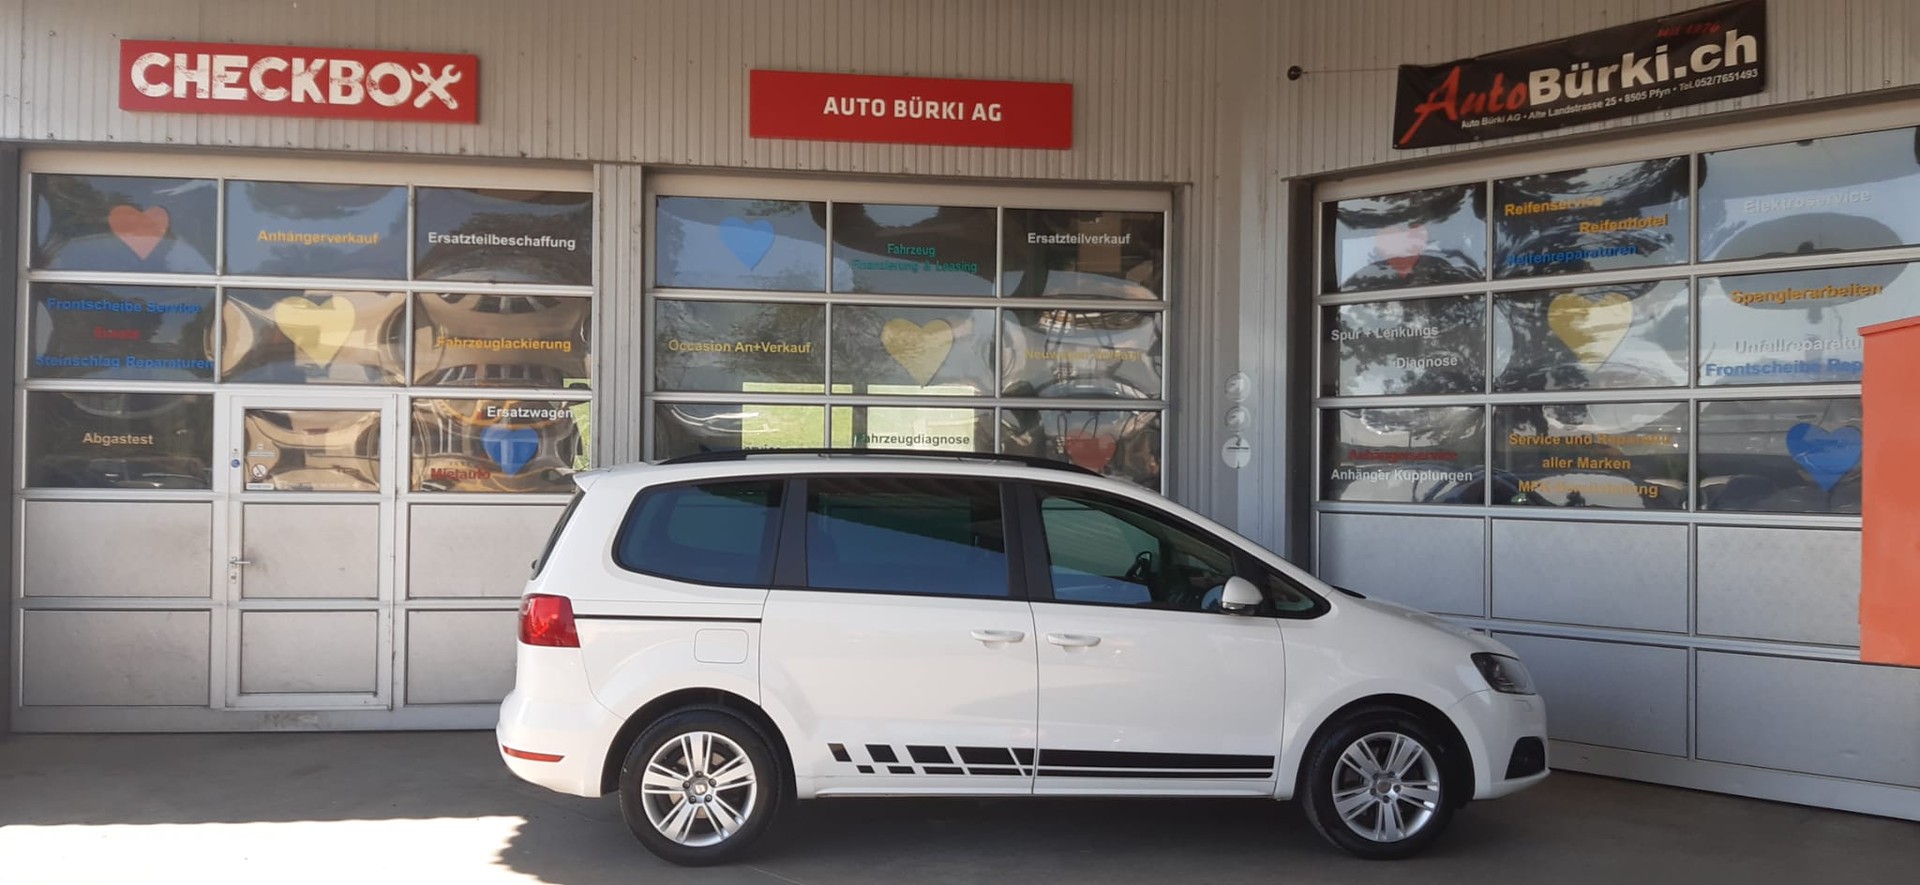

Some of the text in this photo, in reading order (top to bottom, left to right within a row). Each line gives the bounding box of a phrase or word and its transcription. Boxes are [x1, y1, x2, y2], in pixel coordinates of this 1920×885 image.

[131, 52, 462, 109] CHECKBOX
[823, 96, 1002, 122] AUTO BÜRKI AG
[1461, 119, 1480, 129] Auto
[1482, 116, 1505, 126] Bürki
[1506, 113, 1521, 122] AG
[1528, 110, 1547, 119] Alte
[1548, 101, 1603, 117] Landstrasse
[1604, 96, 1616, 107] 25
[1649, 87, 1671, 99] Pfyn
[1504, 195, 1604, 217] Reifenservice
[1745, 190, 1872, 215] Elektroservice
[1579, 213, 1668, 234] Reifenhotel
[257, 229, 381, 246] Anhängerverkauf
[427, 231, 576, 251] Ersatzteilbeschaffung
[1027, 232, 1132, 245] Ersatzteilverkauf
[887, 243, 936, 257] Fahrzeug
[936, 261, 978, 273] Leasing
[1730, 283, 1883, 305] Spenglerarbeiten
[47, 297, 142, 312] Frontscheibe
[1331, 329, 1361, 342] Spur
[1375, 326, 1439, 339] Lenkungs
[436, 335, 572, 352] Fahrzeuglackierung
[668, 339, 812, 353] Occasion An+Verkauf
[1736, 336, 1862, 354] Unfallreparatu
[35, 355, 120, 369] Steinschlag
[1396, 356, 1458, 369] Diagnose
[1705, 358, 1863, 377] Frontscheibe Rep
[487, 406, 573, 421] Ersatzwagen
[82, 432, 154, 446] Abgastest
[1509, 433, 1560, 446] Service
[1565, 433, 1592, 445] und
[1542, 457, 1631, 470] aller Marken
[430, 467, 491, 481] Mietauto
[1331, 469, 1473, 484] Anhänger Kupplungen
